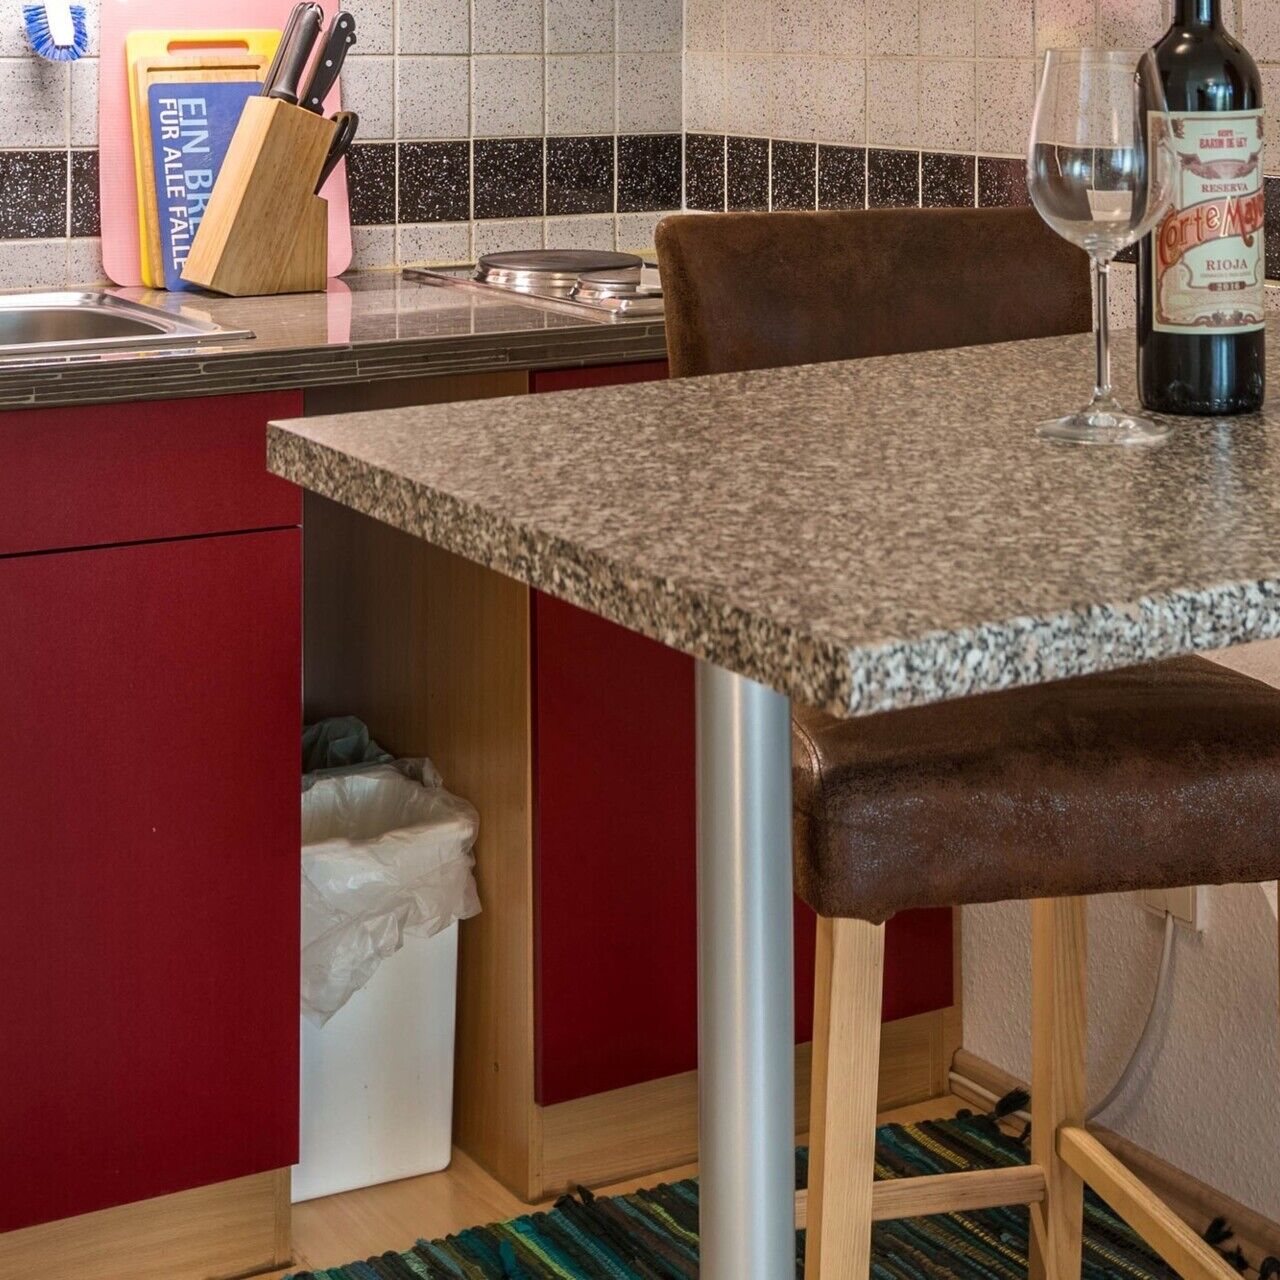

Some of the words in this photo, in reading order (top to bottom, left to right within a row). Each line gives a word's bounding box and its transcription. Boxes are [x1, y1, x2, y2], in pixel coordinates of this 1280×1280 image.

[177, 97, 211, 154] EIN
[163, 147, 187, 199] ALLE
[1201, 183, 1249, 193] RESERVA
[1206, 259, 1248, 271] RIOJA
